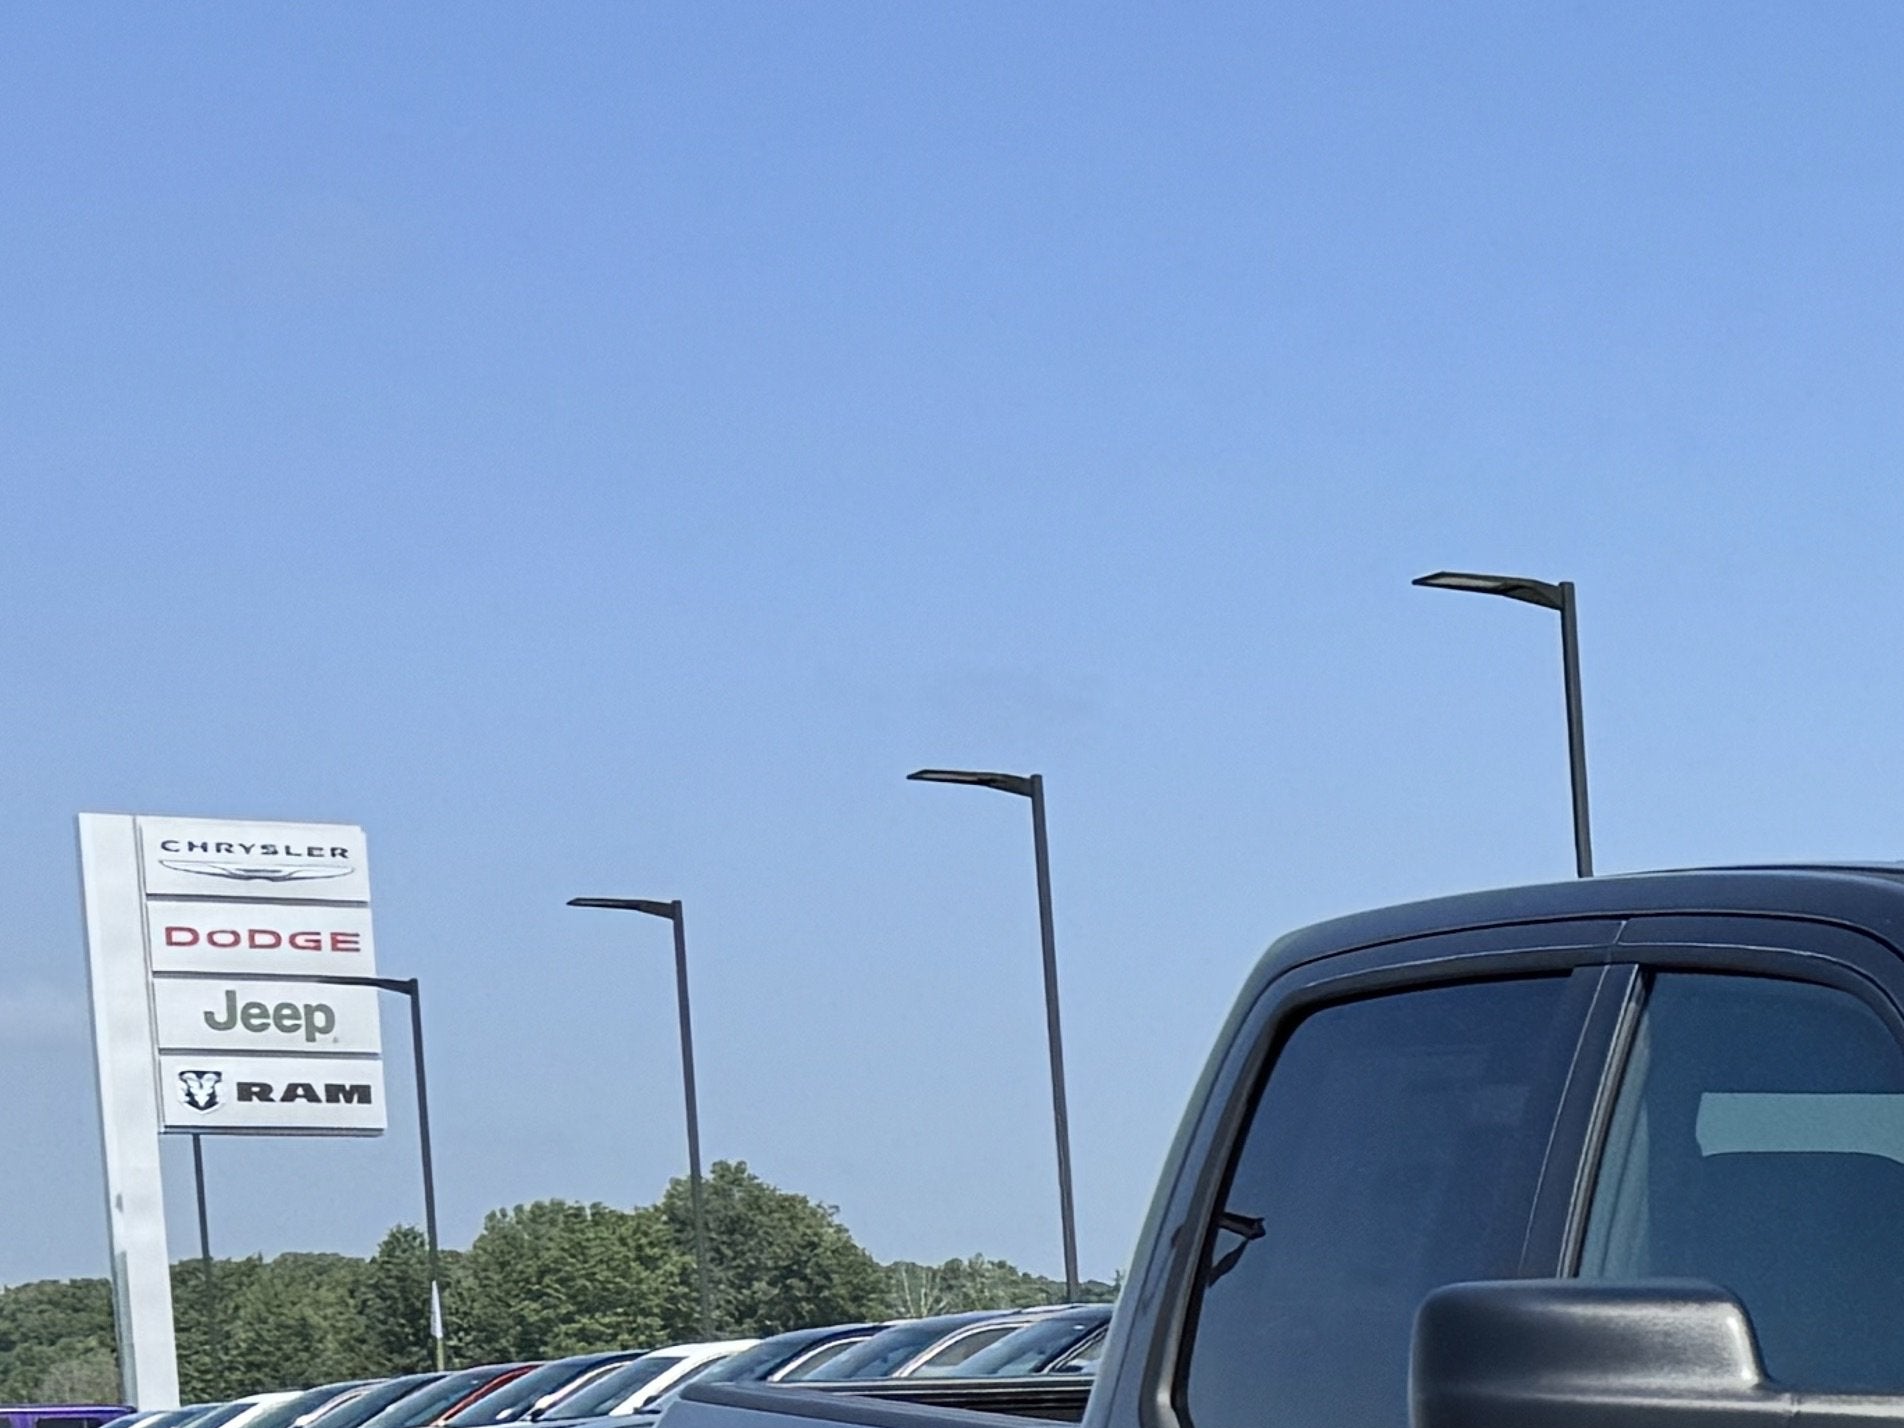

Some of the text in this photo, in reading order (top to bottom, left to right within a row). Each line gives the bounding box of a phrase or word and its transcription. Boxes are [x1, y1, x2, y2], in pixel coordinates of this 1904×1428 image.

[161, 839, 349, 859] CHRYSLER
[165, 926, 361, 952] DODGE
[203, 989, 336, 1043] Jeep
[236, 1081, 373, 1105] RAM
